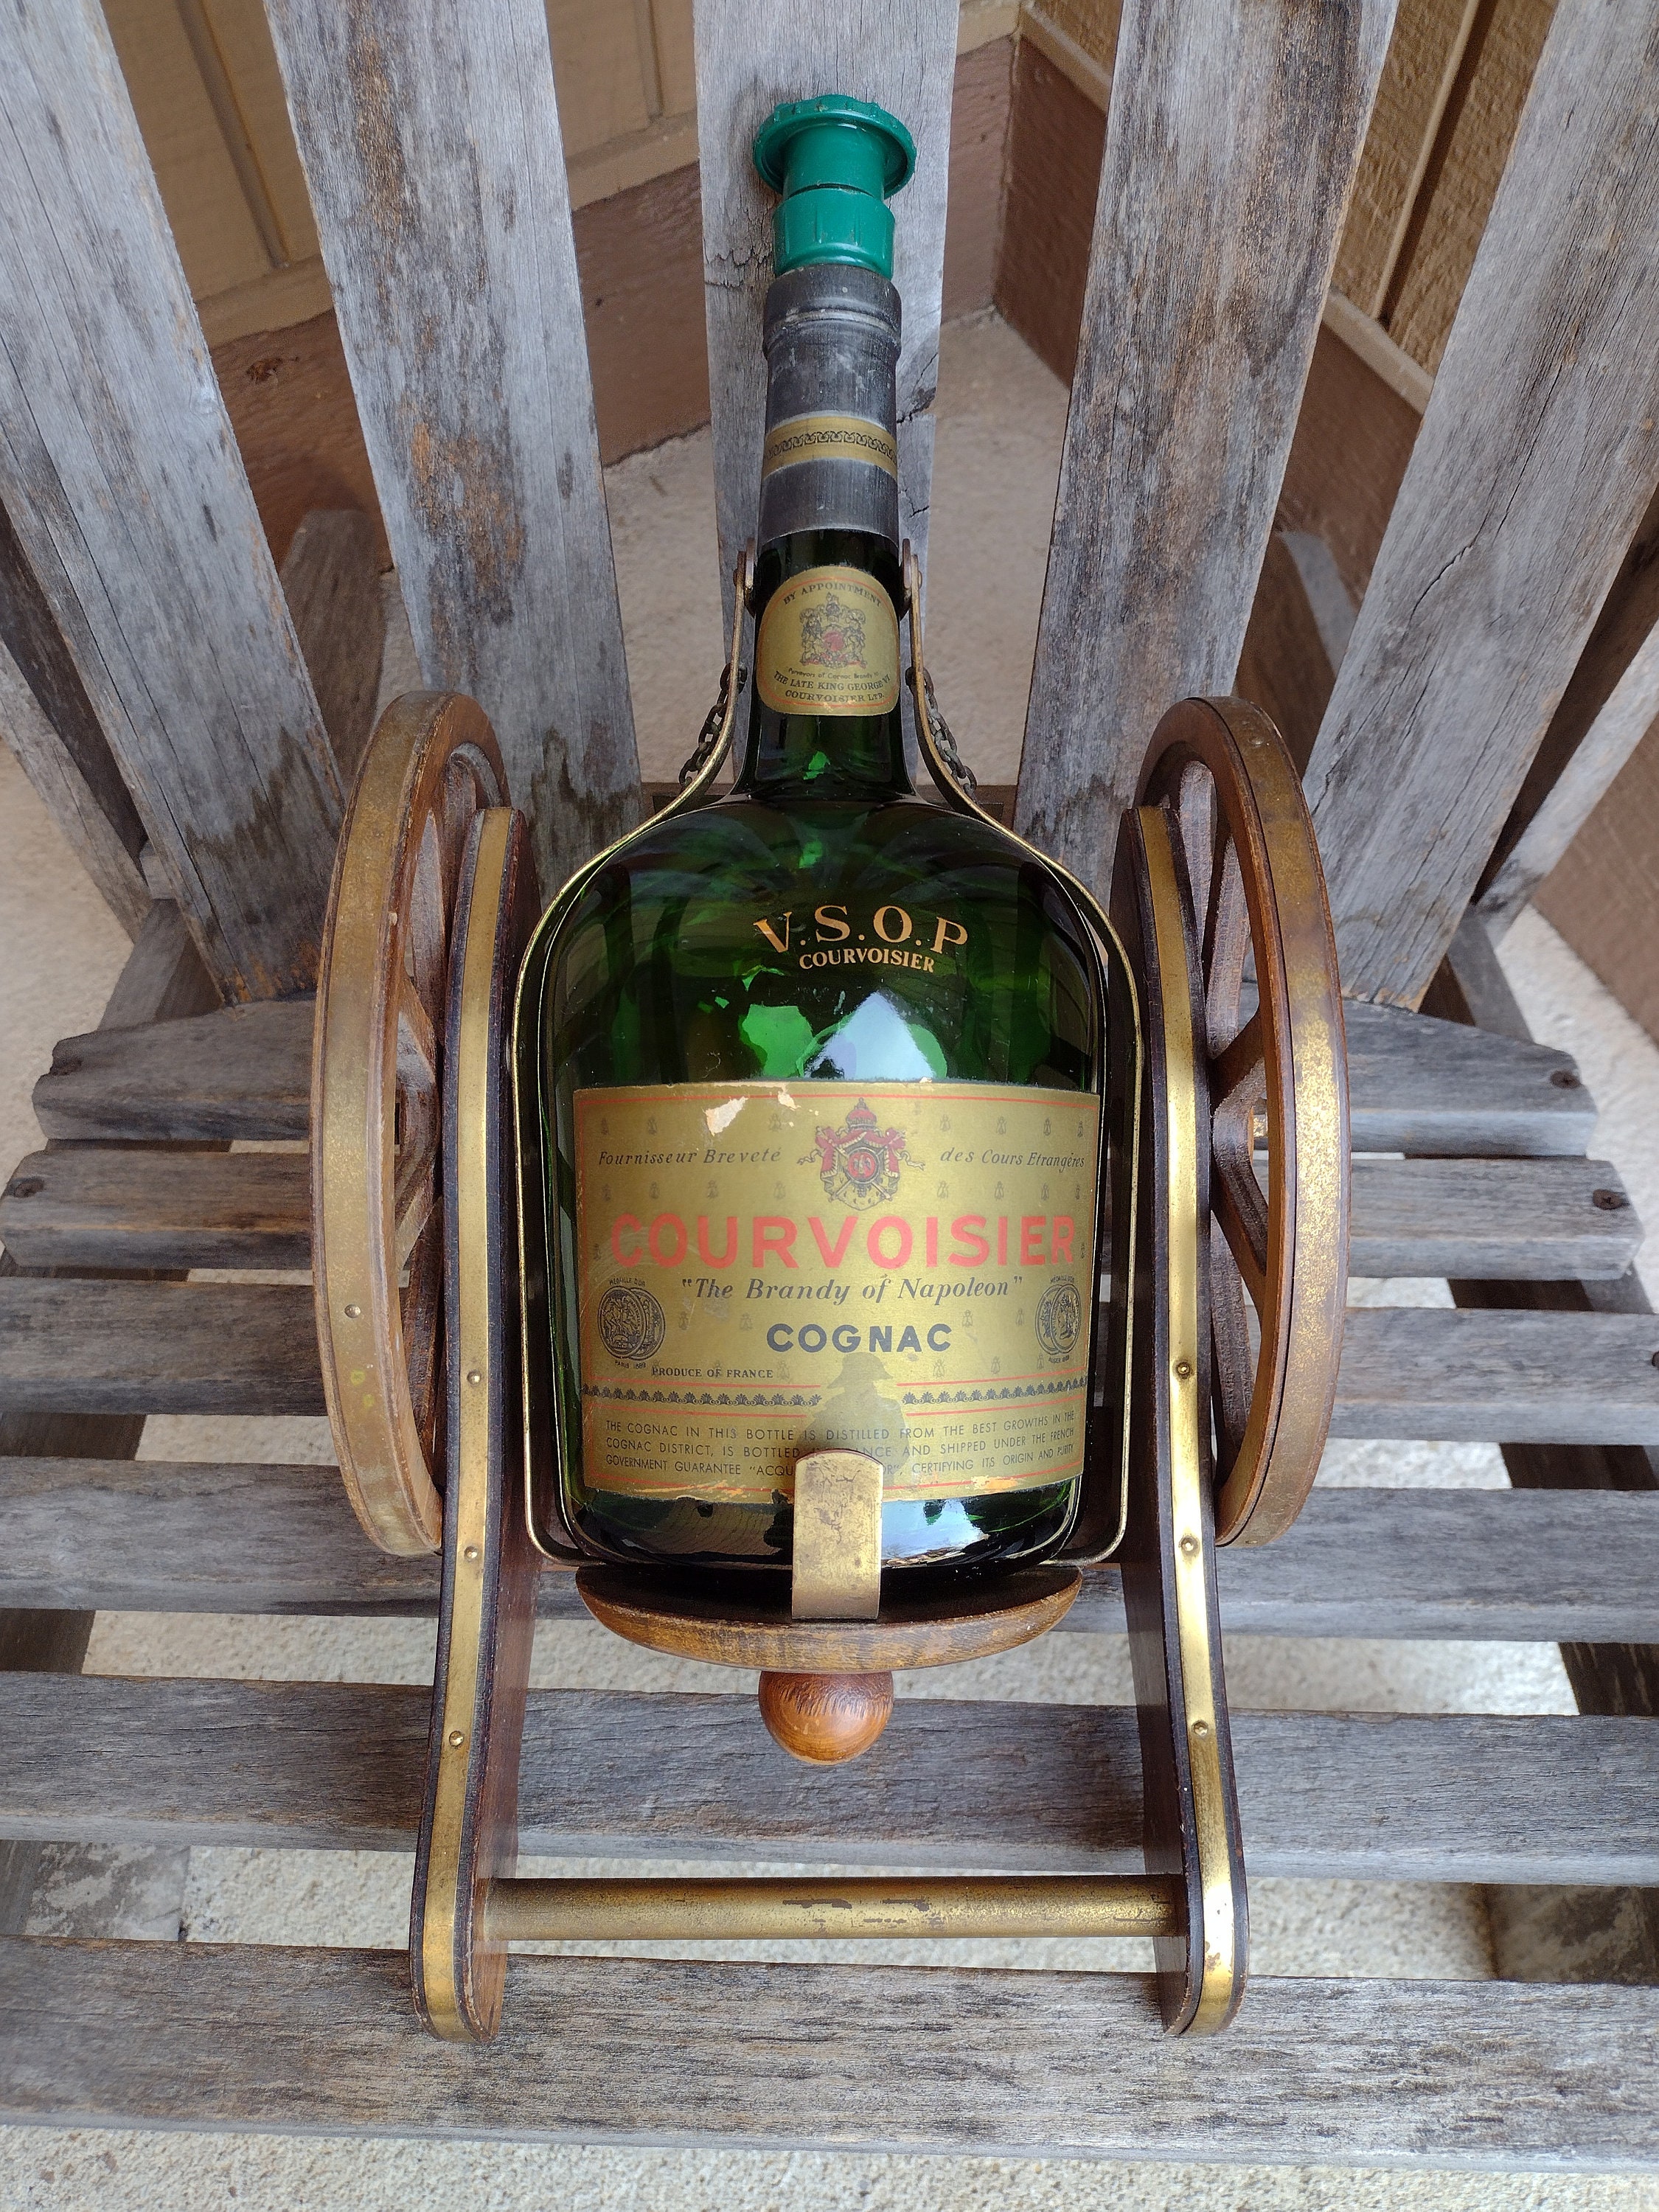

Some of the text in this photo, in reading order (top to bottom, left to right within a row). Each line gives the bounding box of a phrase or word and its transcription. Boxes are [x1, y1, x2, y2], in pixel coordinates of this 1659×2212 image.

[783, 582, 883, 608] BY APPOINTMENT
[774, 670, 891, 691] THE LATE KING GEORGE VI
[785, 689, 866, 703] COURVOISIER
[753, 905, 969, 956] V.S.O.P
[799, 947, 936, 973] COURVOISIER
[598, 1147, 782, 1166] Fournisseur Breveté
[940, 1147, 1085, 1173] des Cours Etrangères
[611, 1211, 1077, 1270] COURVOISIER
[745, 1278, 850, 1305] Brandy
[862, 1278, 891, 1304] of
[766, 1324, 953, 1353] COGNAC
[651, 1366, 773, 1380] PRODUCE OF FRANCE
[605, 1410, 1075, 1440] THE COGNAC IN THIS BOTTLE IS DISTILLED FROM THE BEST GROWTHS IN THE
[606, 1437, 652, 1453] COGNAC
[659, 1441, 714, 1457] DISTRICT,
[723, 1445, 734, 1457] IS
[743, 1447, 800, 1458] BOTTLED
[902, 1445, 931, 1457] AND
[939, 1440, 986, 1455] SHIPPED
[994, 1436, 1027, 1450] UNDER
[1031, 1433, 1046, 1446] THE
[1050, 1427, 1074, 1443] FRENCH
[606, 1454, 668, 1471] GOVERNMENT
[675, 1461, 741, 1475] GUARANTEE
[749, 1464, 795, 1477] "ACQU
[912, 1459, 974, 1475] CERTIFYING
[981, 1456, 995, 1469] ITS
[1003, 1451, 1033, 1466] ORIGIN
[1038, 1447, 1054, 1461] AND
[1057, 1443, 1074, 1458] PURITY
